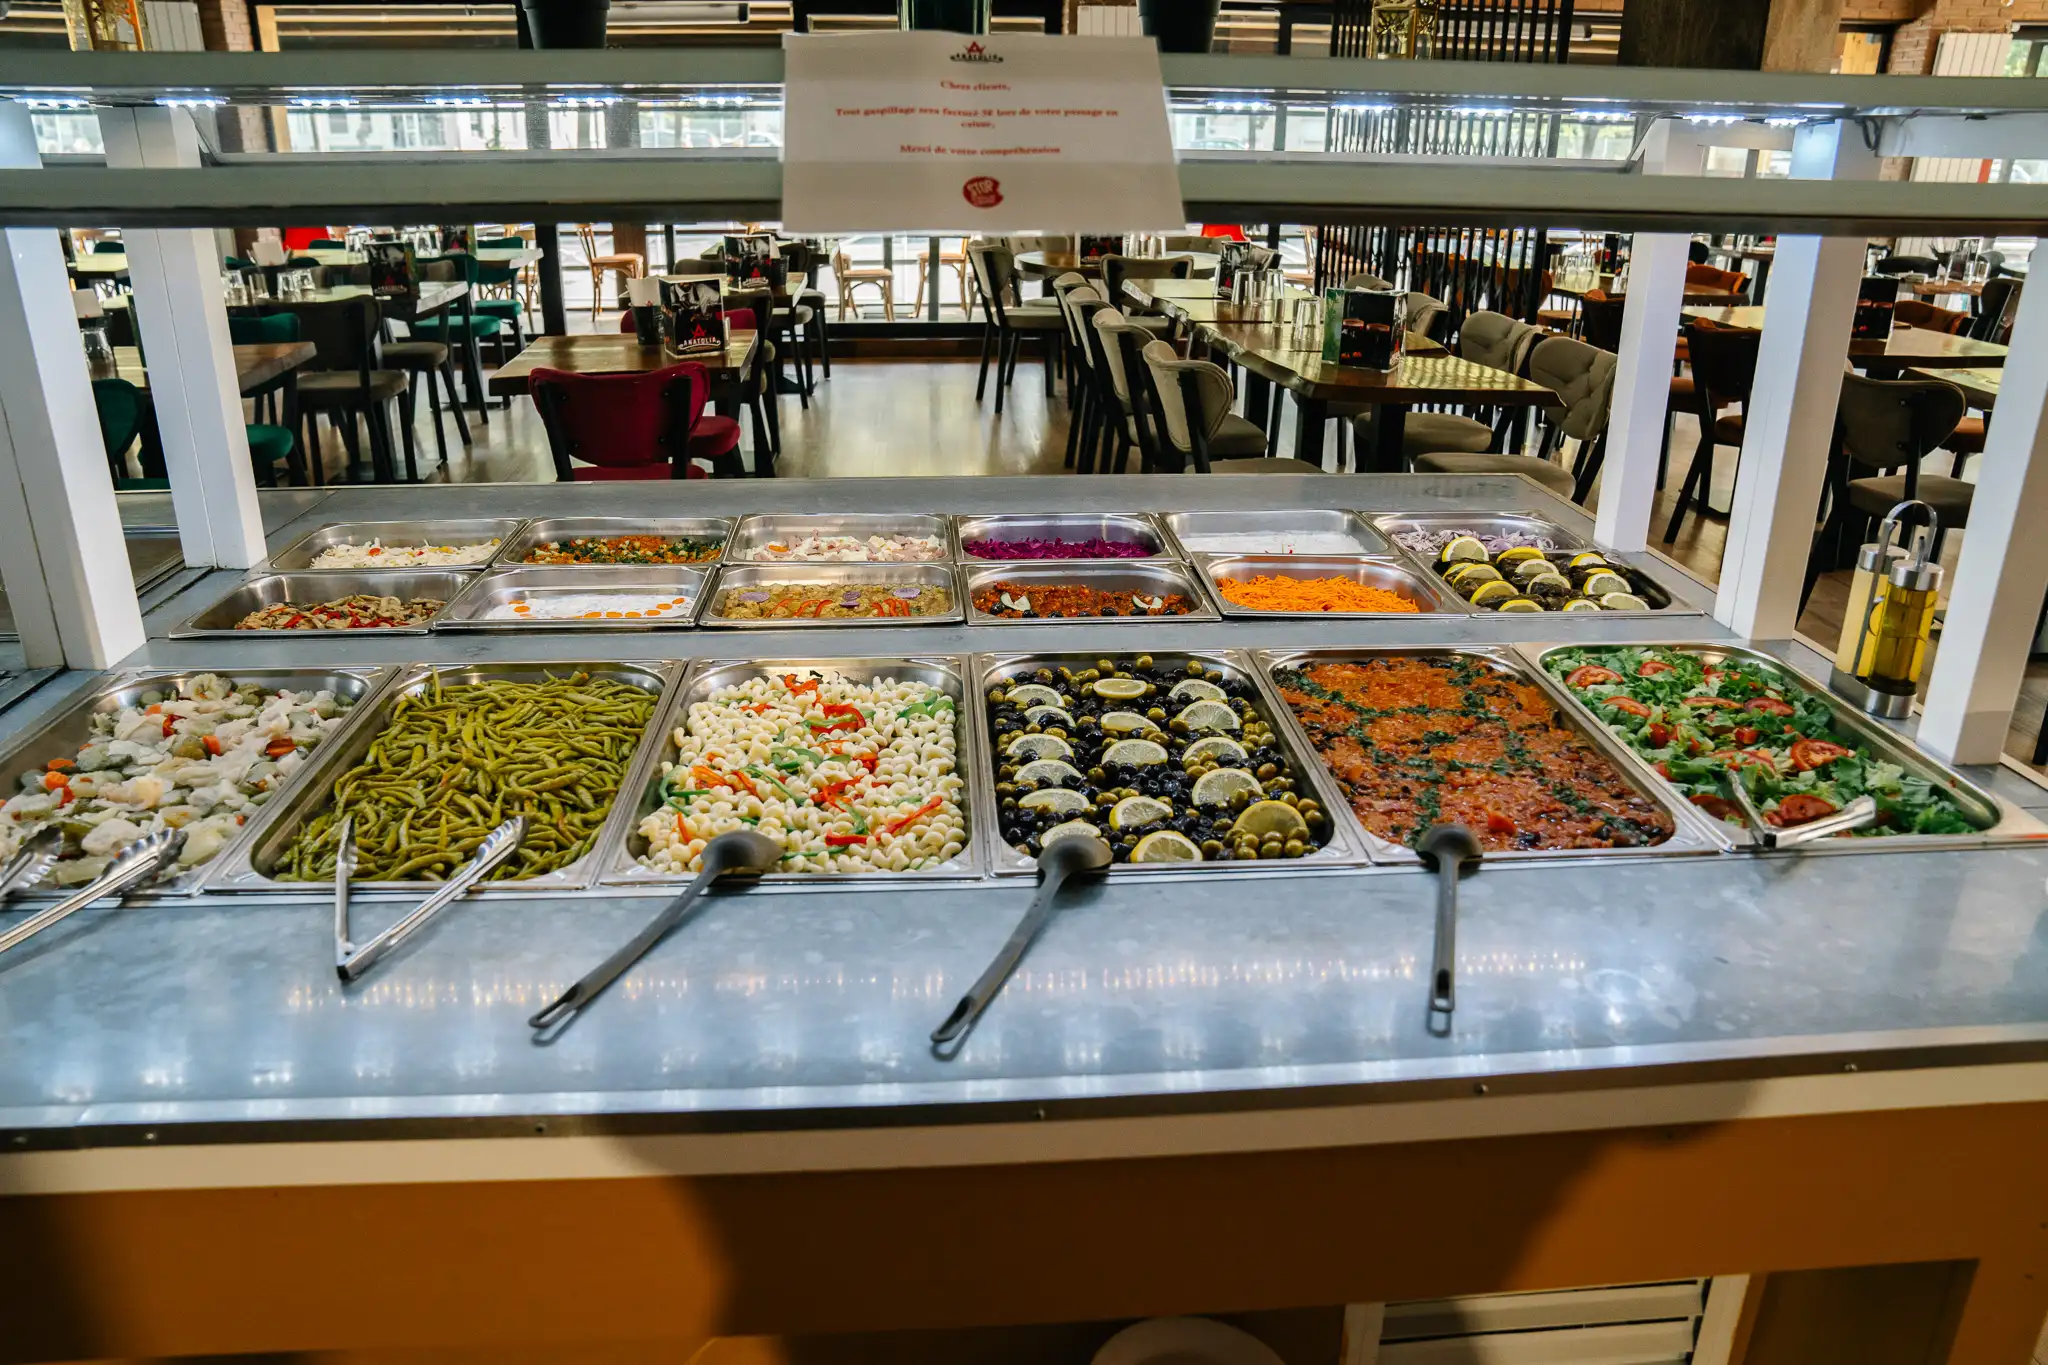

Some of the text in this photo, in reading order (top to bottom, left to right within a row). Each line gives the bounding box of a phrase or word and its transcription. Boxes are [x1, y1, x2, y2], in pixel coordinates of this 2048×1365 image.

[836, 107, 861, 116] Tout
[863, 105, 915, 118] gaspillage
[919, 107, 940, 115] sera
[1019, 107, 1031, 116] de
[1034, 107, 1061, 116] votre
[899, 143, 932, 154] Merci
[934, 144, 947, 154] de
[949, 146, 978, 155] votre
[683, 336, 717, 346] ANATOLIA
